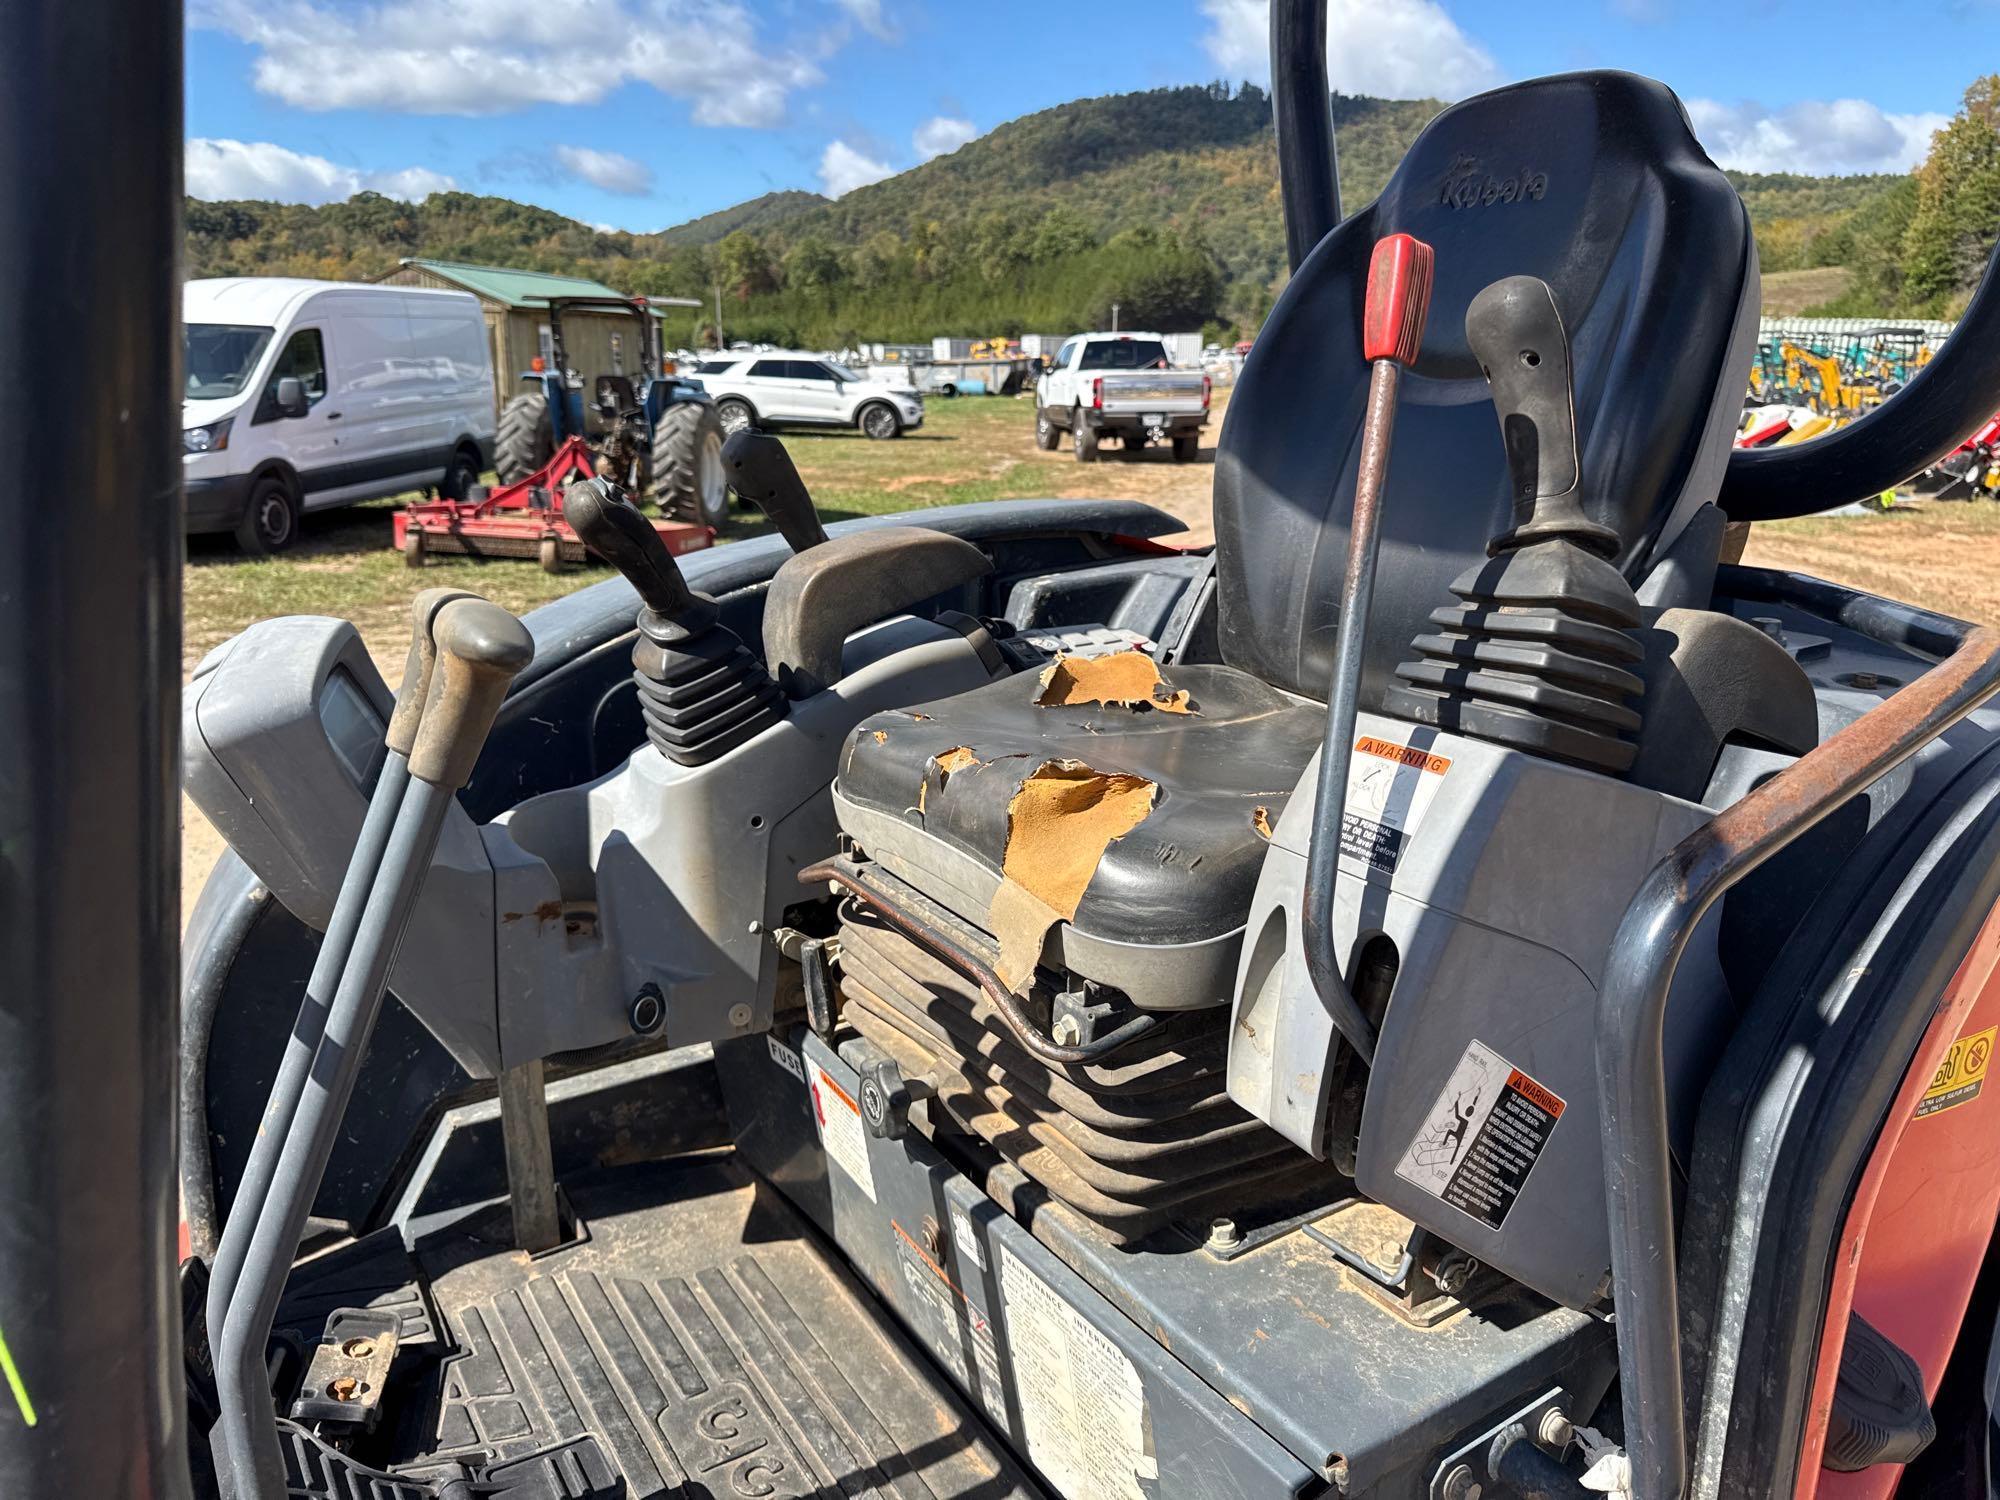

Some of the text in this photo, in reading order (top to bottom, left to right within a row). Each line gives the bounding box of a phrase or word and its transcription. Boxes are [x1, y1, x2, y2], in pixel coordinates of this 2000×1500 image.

[1375, 743, 1442, 771] WARNING
[1352, 827, 1362, 836] OR
[1363, 830, 1386, 845] DEATH:
[1360, 819, 1391, 837] PERSONAL
[1340, 841, 1377, 860] ompartment.
[1356, 837, 1373, 849] lever
[1375, 845, 1396, 858] before
[772, 1043, 802, 1075] FUSE
[1523, 1082, 1560, 1113] WARNING
[1005, 1255, 1062, 1312] MAINTENANCE
[1074, 1316, 1124, 1366] INTERVALS
